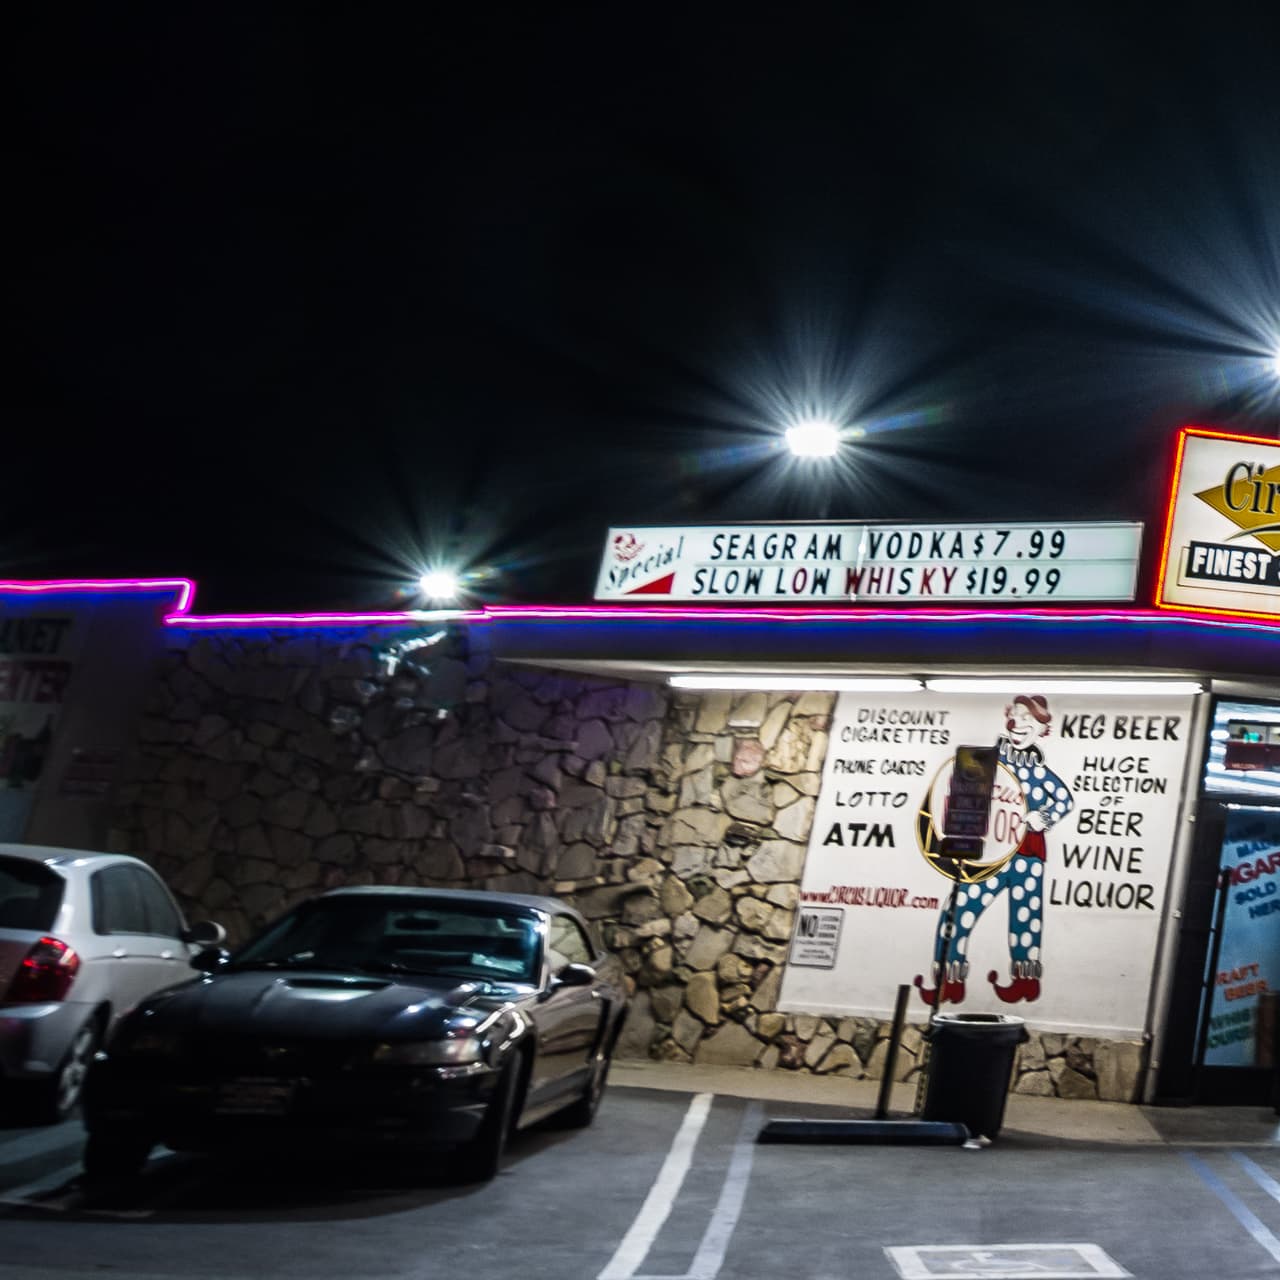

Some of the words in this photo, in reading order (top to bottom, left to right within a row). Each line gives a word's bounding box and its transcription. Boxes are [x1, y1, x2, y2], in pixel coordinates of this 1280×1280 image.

[711, 533, 842, 560] SEAGRAM
[868, 531, 963, 559] VODKA
[973, 530, 1065, 559] $7.99
[1191, 546, 1273, 580] FINEST
[692, 568, 763, 595] SLOW
[775, 569, 830, 595] LOW
[844, 566, 958, 595] WHISKY
[966, 566, 1062, 595] $19.99
[857, 708, 949, 725] DISCOUNT
[1060, 714, 1106, 739] KEG
[1113, 716, 1182, 741] BEER
[841, 726, 950, 745] CIGARETTES
[1083, 756, 1150, 773] HUGE
[1072, 775, 1168, 794] SELECTION
[835, 791, 909, 808] LOTTO
[1099, 795, 1125, 807] OF
[822, 822, 896, 848] ATM
[1076, 808, 1144, 837] BEER
[1063, 843, 1144, 874] WINE
[1050, 878, 1155, 910] LIQUOR
